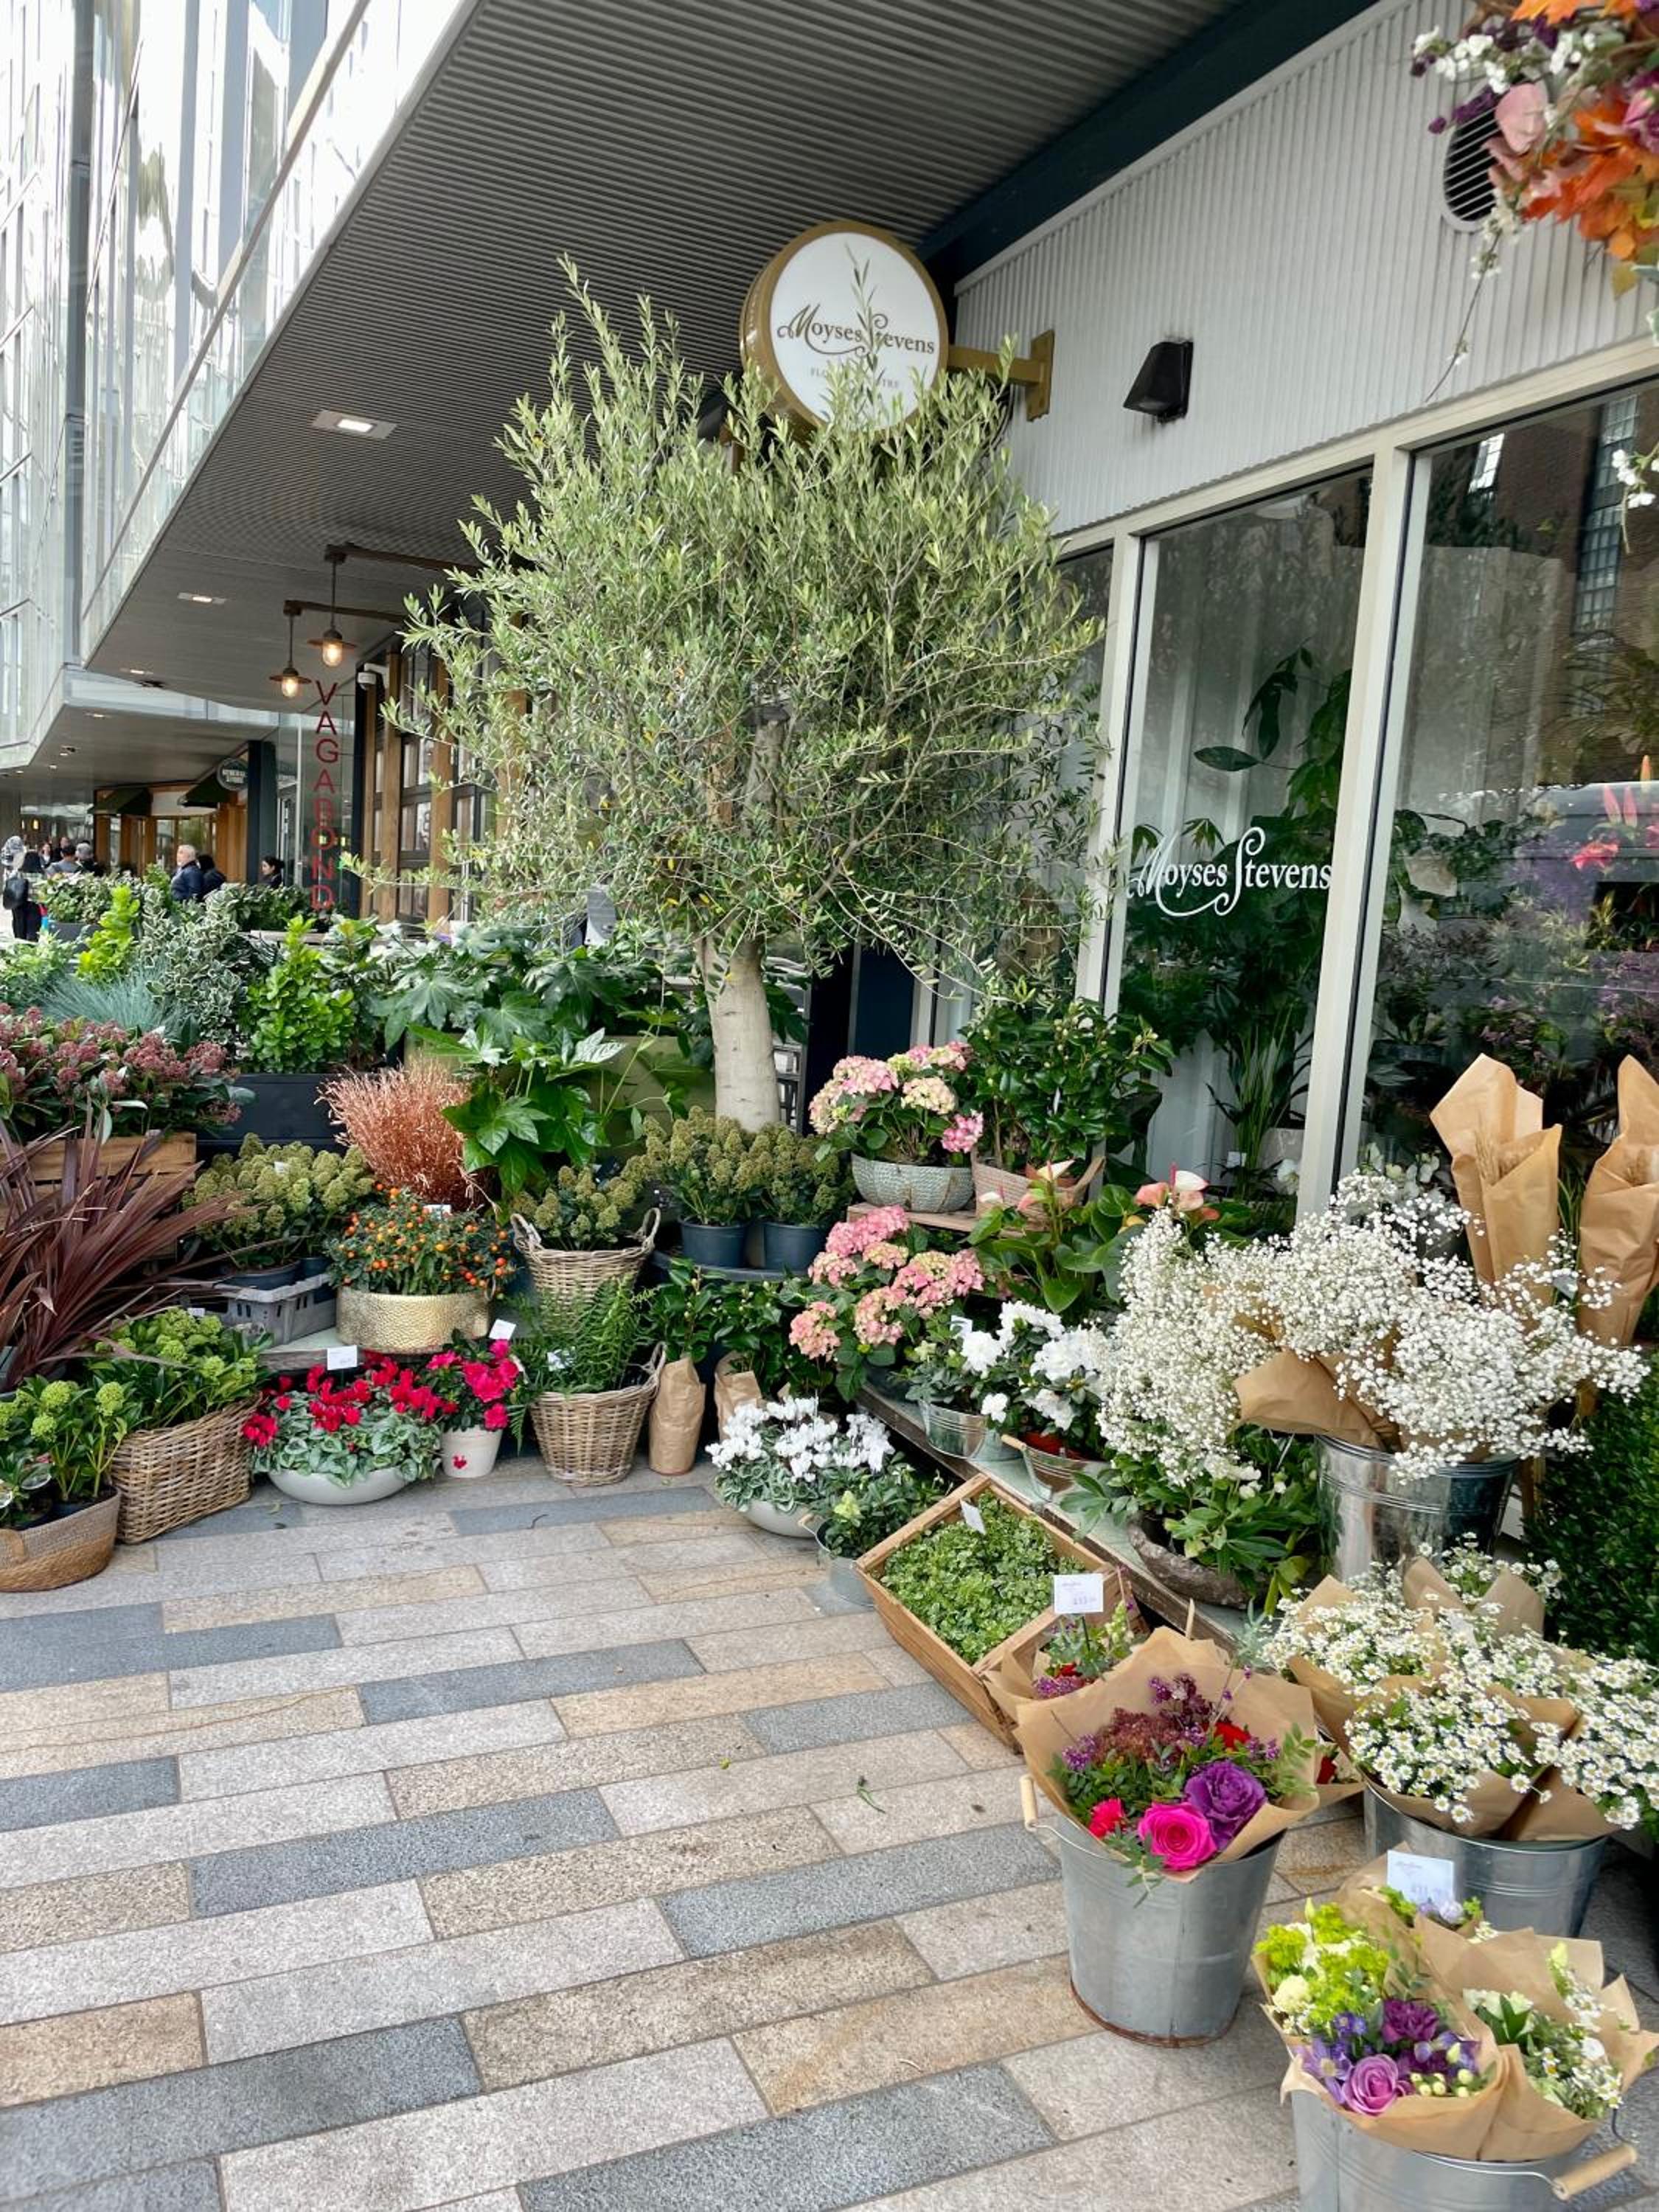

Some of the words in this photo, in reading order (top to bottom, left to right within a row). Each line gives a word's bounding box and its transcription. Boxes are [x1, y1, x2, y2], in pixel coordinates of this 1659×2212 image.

[776, 304, 866, 355] Moyses
[310, 680, 338, 909] VAGABOND
[1127, 827, 1228, 917] Moyses
[1214, 826, 1332, 917] Stevens
